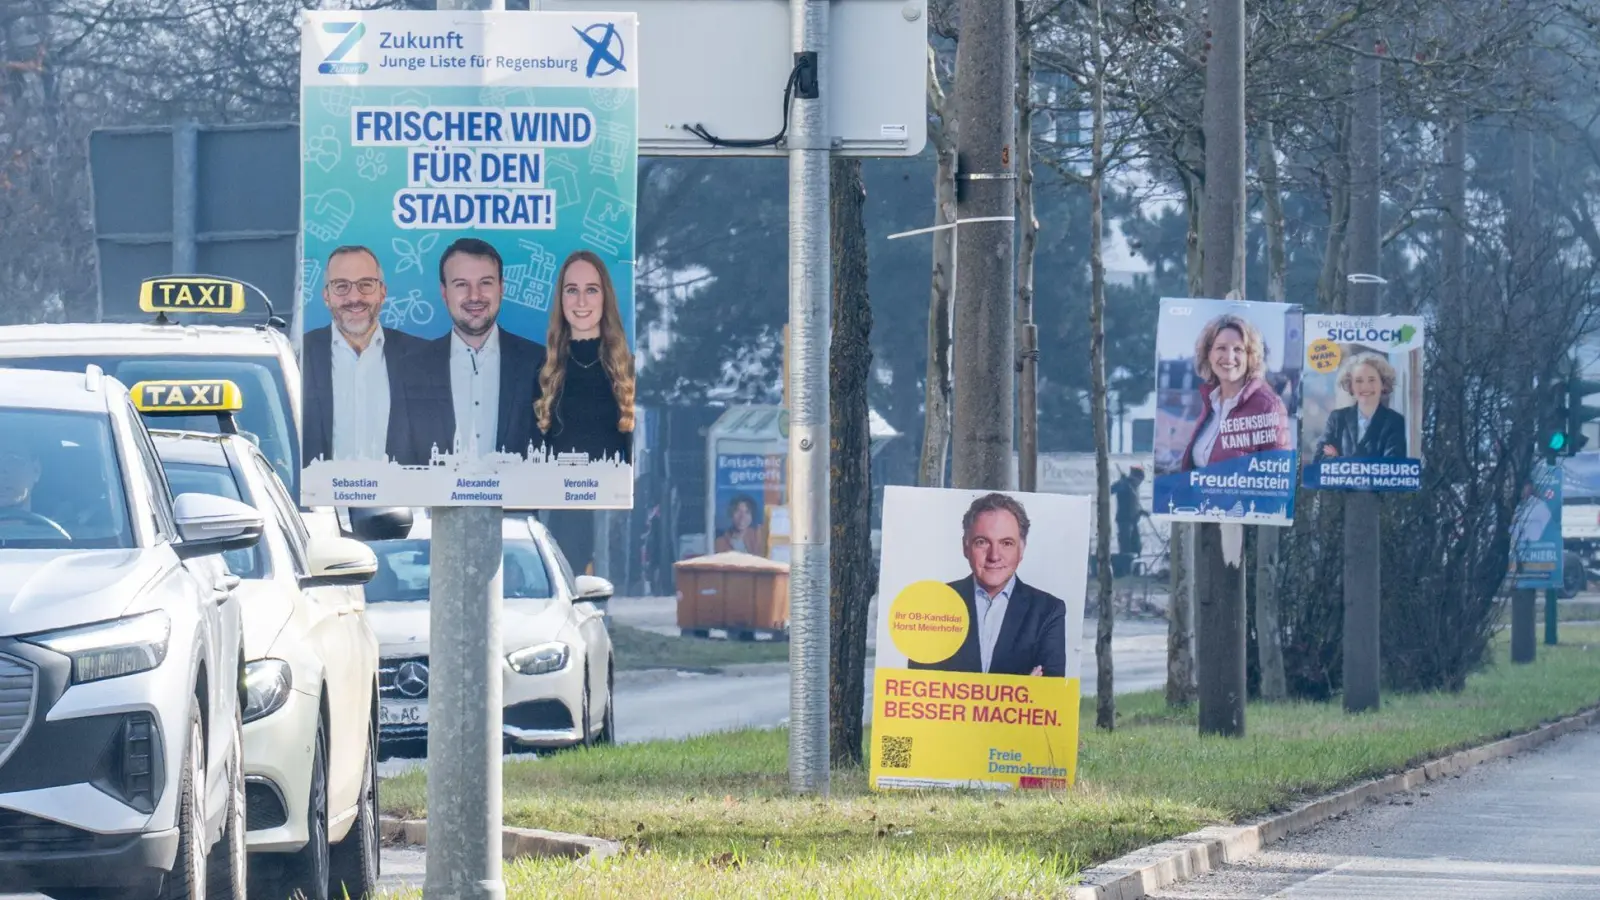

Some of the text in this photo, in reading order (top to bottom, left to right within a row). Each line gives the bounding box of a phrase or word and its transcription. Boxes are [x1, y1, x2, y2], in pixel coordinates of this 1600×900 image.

[379, 31, 464, 49] Zukunft
[379, 55, 578, 72] Junge Liste für Regensburg
[356, 110, 592, 143] FRISCHER WIND
[412, 146, 540, 183] FÜR DEN
[398, 193, 551, 225] STADTRAT!
[158, 284, 225, 306] TAXI
[1327, 328, 1402, 342] SIGLOCH
[146, 385, 221, 405] TAXI
[1220, 412, 1280, 434] REGENSBURG
[1221, 428, 1277, 449] KANN MEHR
[1248, 457, 1290, 473] Astrid
[1320, 463, 1419, 476] REGENSBURG
[332, 478, 378, 489] Sebastian
[456, 478, 500, 487] Alexander
[564, 478, 599, 488] Veronika
[1190, 471, 1289, 490] Freudenstein
[1320, 475, 1420, 487] EINFACH MACHEN
[333, 491, 377, 502] Löschner
[565, 491, 597, 501] Brandel
[894, 611, 906, 620] Ihr
[892, 621, 916, 631] Horst
[885, 678, 1034, 704] REGENSBURG.
[401, 706, 420, 721] AC
[884, 701, 1062, 727] BESSER MACHEN.
[988, 748, 1022, 761] Freie
[988, 762, 1067, 776] Demokraten
